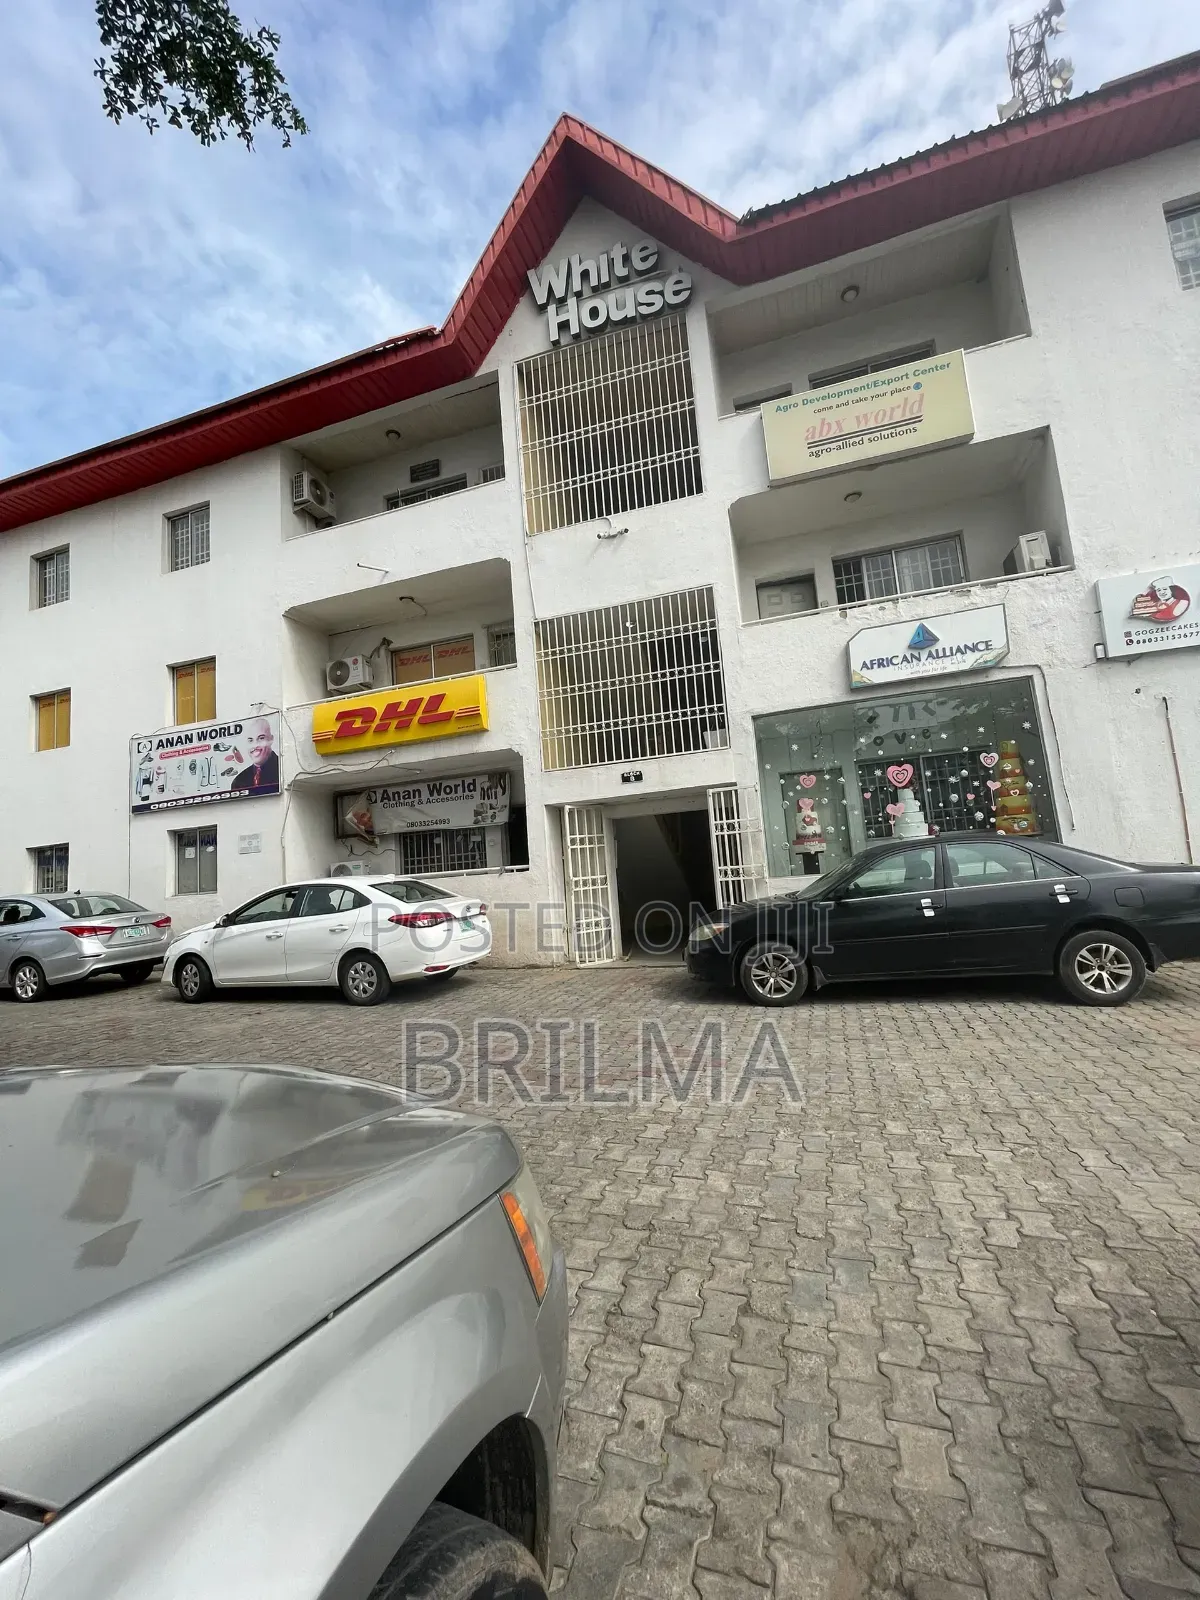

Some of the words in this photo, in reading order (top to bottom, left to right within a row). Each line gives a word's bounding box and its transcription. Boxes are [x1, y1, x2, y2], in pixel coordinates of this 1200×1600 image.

[527, 239, 659, 307] White
[547, 271, 693, 344] House
[775, 401, 799, 413] Agro
[912, 361, 952, 377] Center
[813, 405, 834, 414] come
[835, 400, 850, 409] and
[851, 395, 868, 405] take
[869, 390, 888, 402] your
[890, 385, 911, 398] place
[804, 413, 848, 442] abx
[854, 392, 925, 428] world
[808, 437, 865, 459] agro-allied
[867, 425, 918, 444] solutions
[1134, 622, 1199, 637] GOGZEECAKES
[860, 651, 922, 672] AFRICAN
[925, 640, 993, 661] ALLIANCE
[893, 659, 945, 671] INSURANCE
[335, 693, 455, 738] DHL
[156, 733, 194, 751] ANAN
[197, 723, 243, 741] WORLD
[380, 787, 421, 803] Anan
[426, 778, 477, 798] World
[382, 801, 416, 809] Clothing
[425, 794, 475, 805] Accessories
